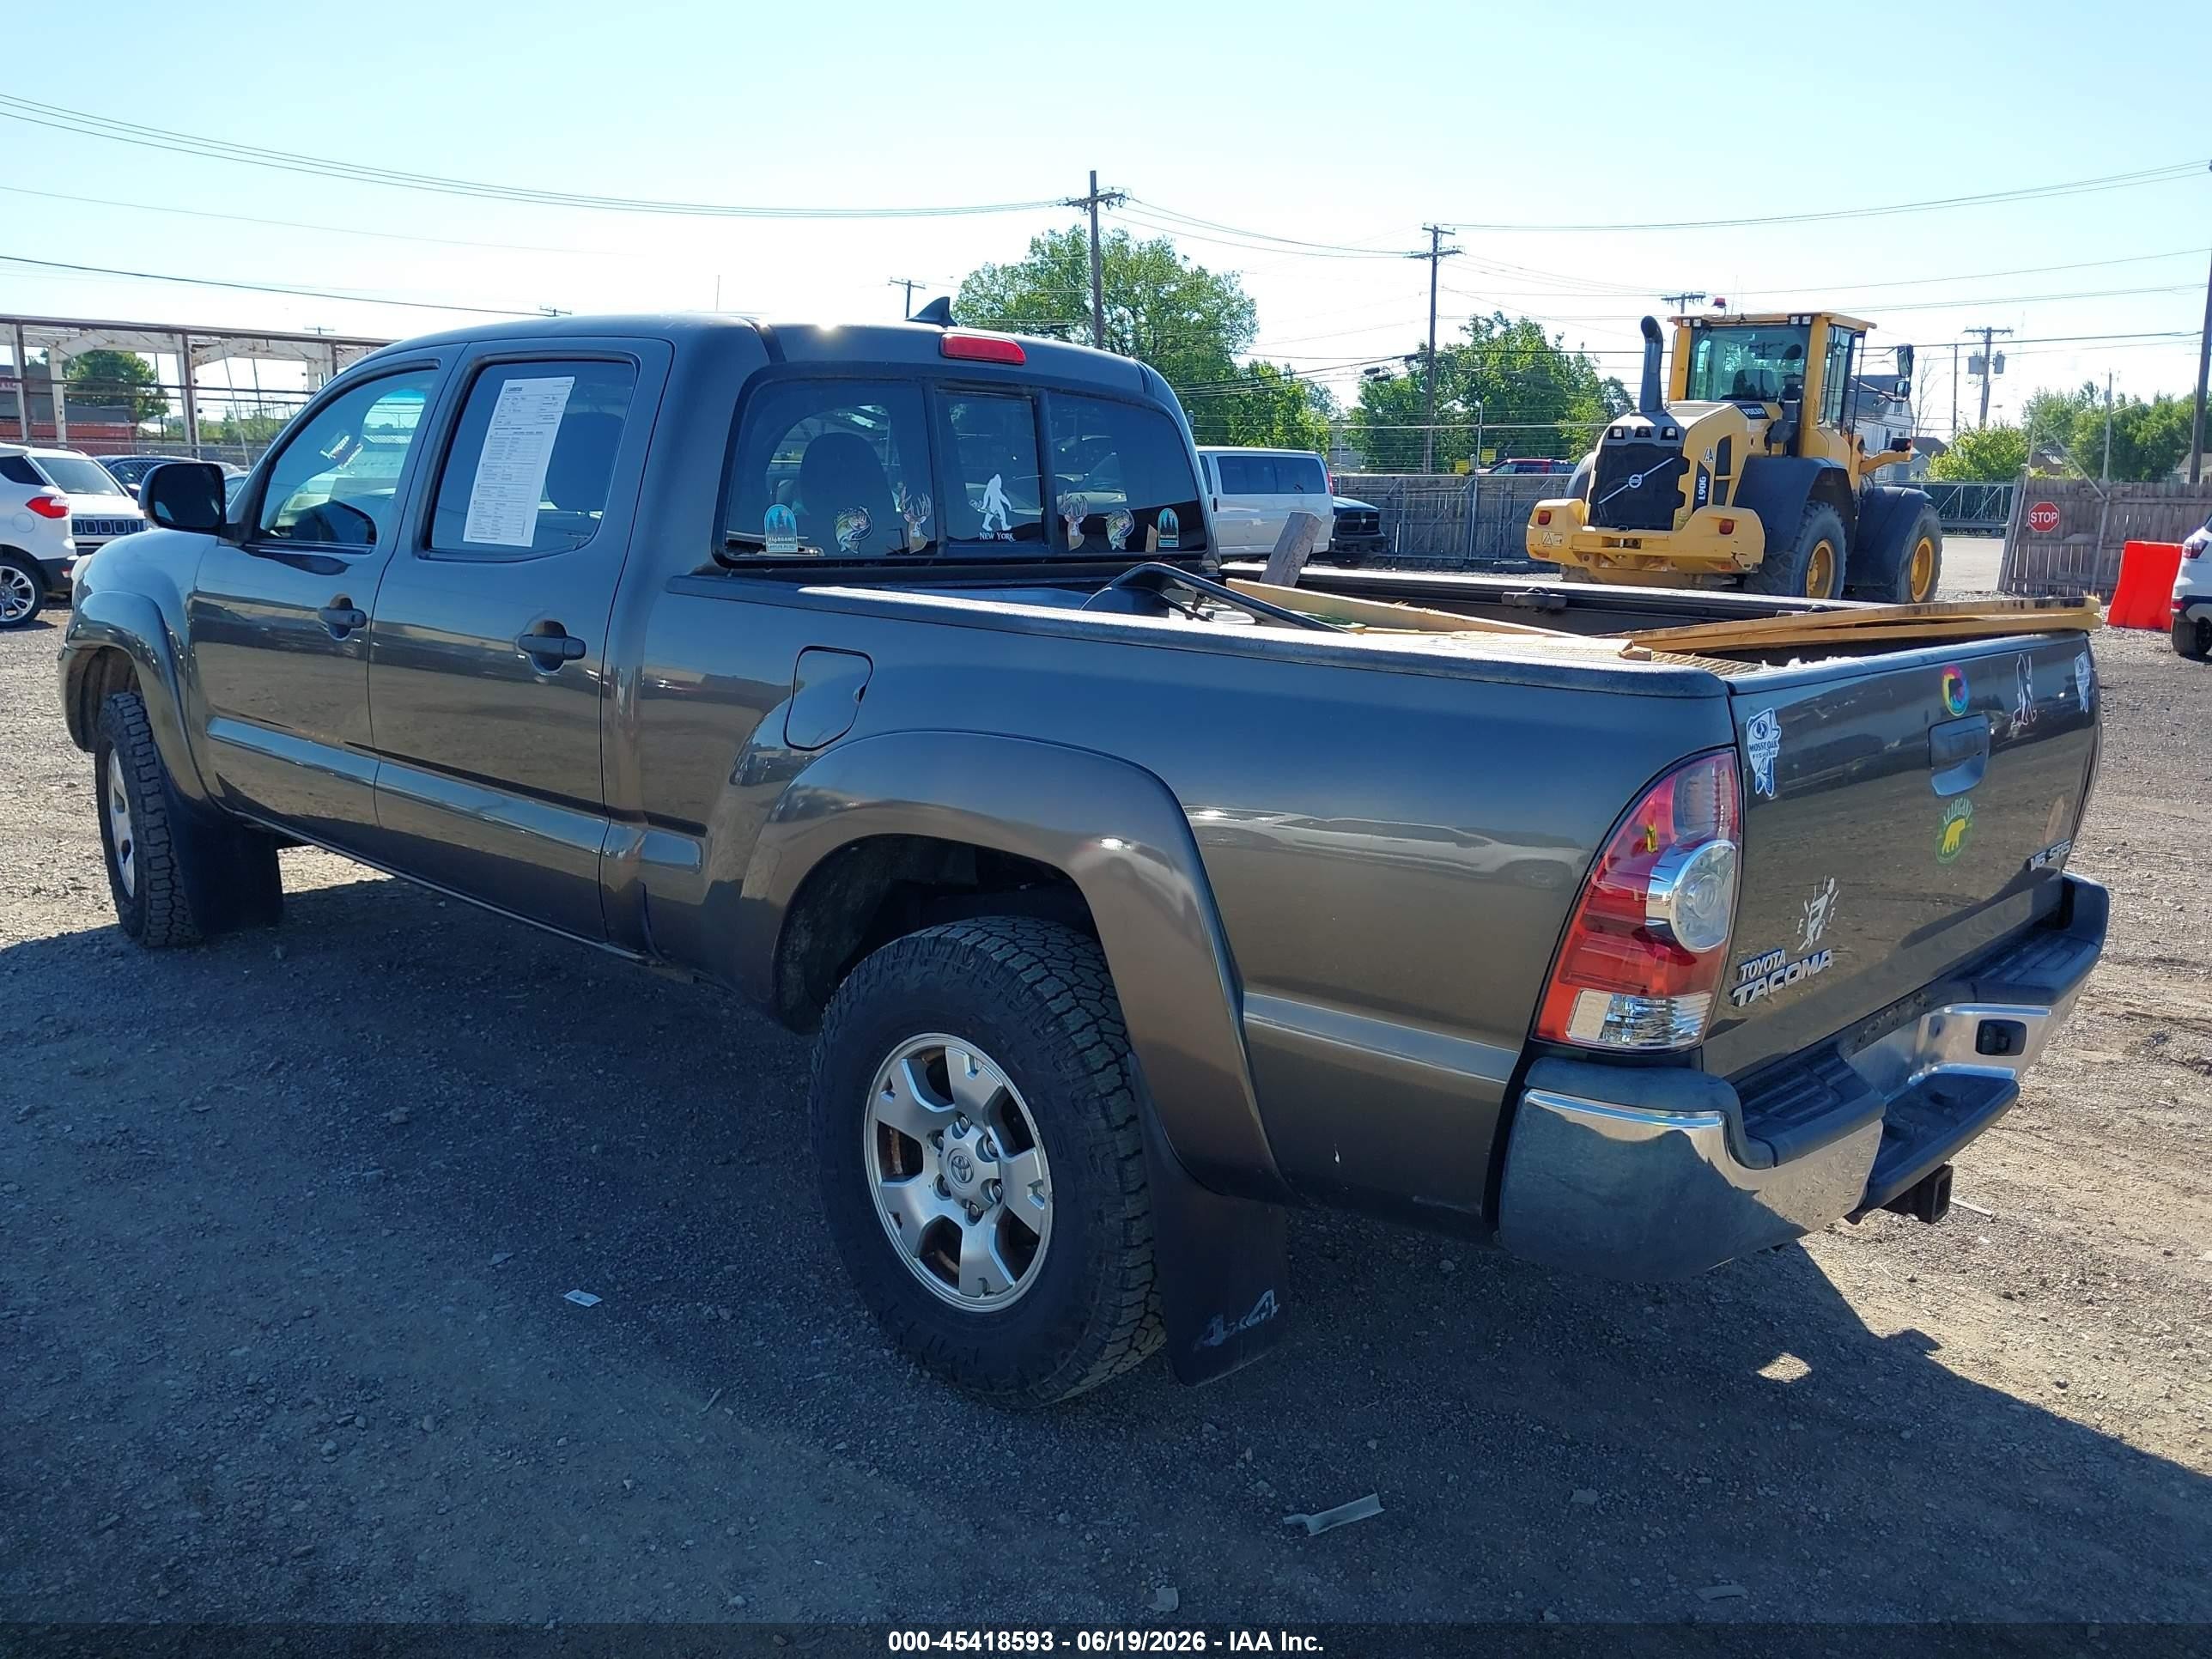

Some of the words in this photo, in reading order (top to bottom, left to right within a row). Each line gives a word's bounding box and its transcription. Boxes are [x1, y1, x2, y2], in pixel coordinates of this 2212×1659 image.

[1698, 476, 1707, 501] L90G
[2030, 511, 2058, 523] STOP
[979, 532, 994, 540] NEW
[996, 532, 1016, 543] YORK
[1748, 742, 1767, 752] MOSSY
[1740, 949, 1786, 982] TOYOTA
[1732, 949, 1833, 1007] TACOMA
